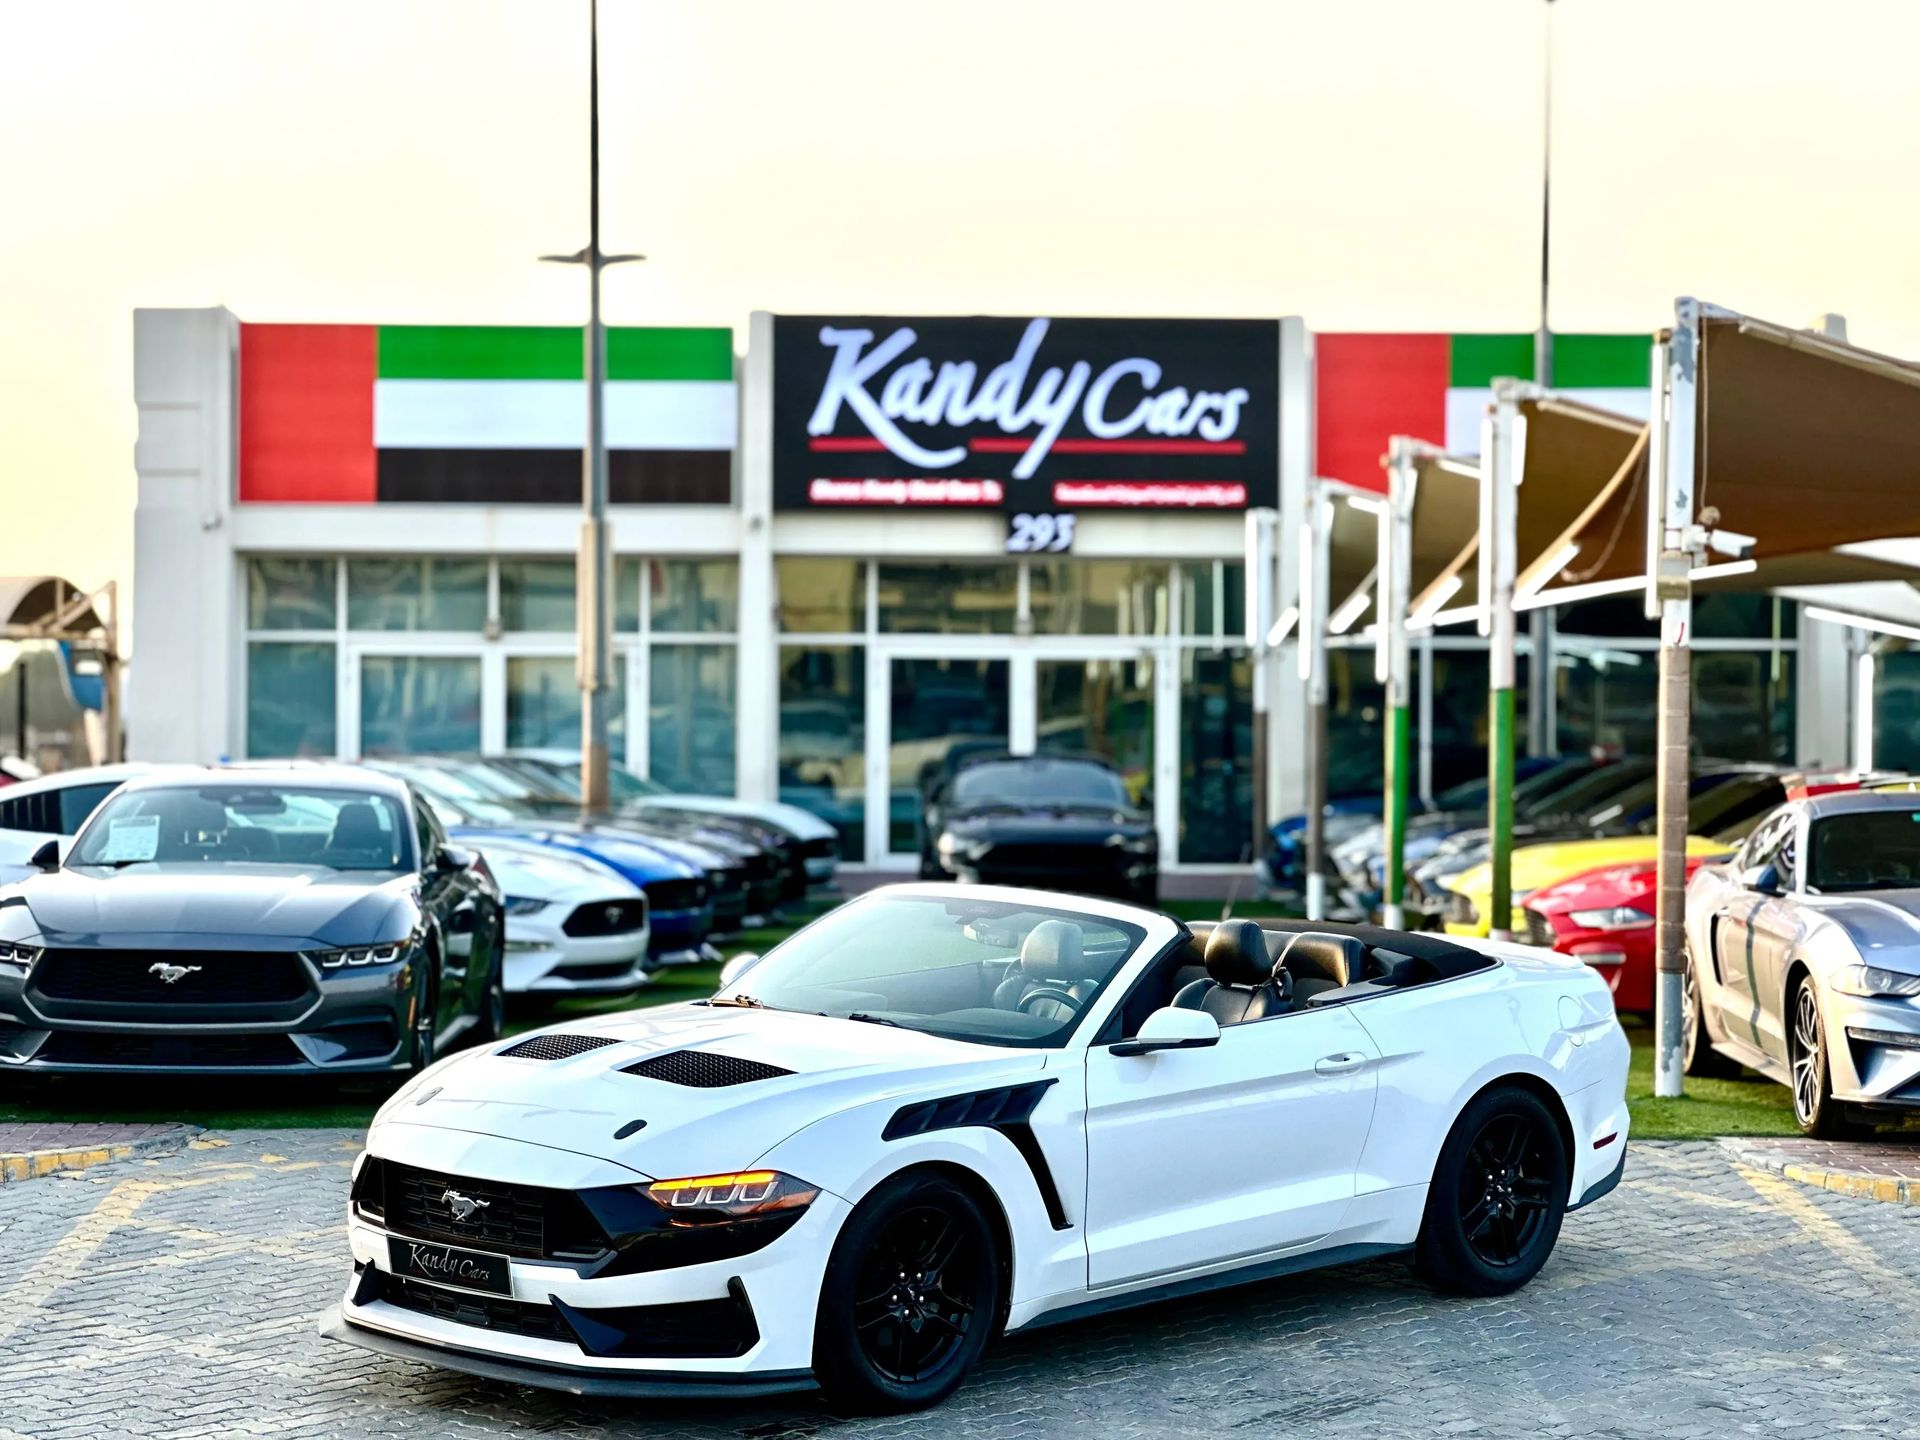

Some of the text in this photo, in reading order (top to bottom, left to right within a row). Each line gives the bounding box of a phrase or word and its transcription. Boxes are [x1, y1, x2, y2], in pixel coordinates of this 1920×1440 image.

[808, 317, 1249, 479] Kandy Cars
[409, 1243, 490, 1280] Kandy Cars
